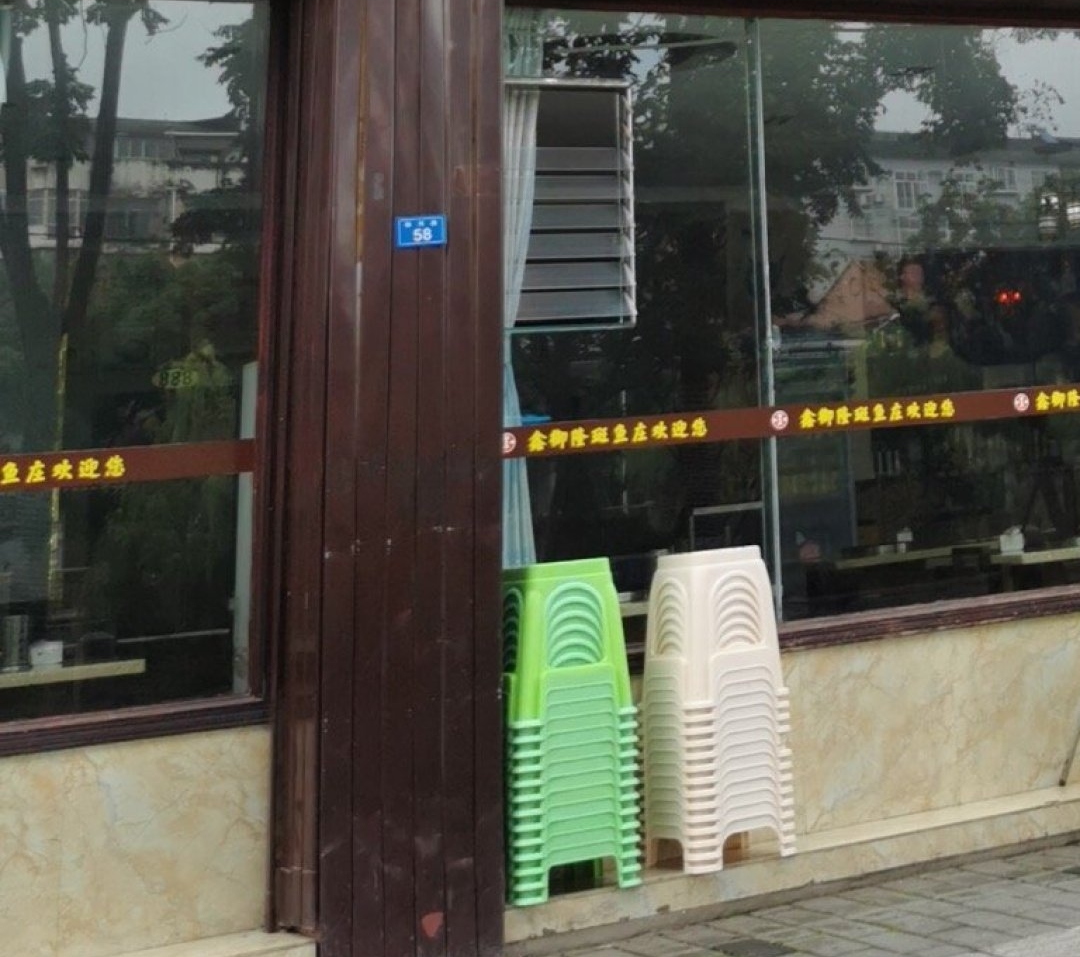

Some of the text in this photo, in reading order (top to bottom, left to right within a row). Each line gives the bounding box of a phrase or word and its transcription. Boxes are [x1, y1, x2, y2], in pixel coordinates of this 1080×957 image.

[413, 227, 433, 242] 58
[799, 398, 956, 430] 鑫御隆斑鱼庄欢迎您
[527, 416, 708, 453] 鑫御隆斑鱼庄欢迎您
[0, 454, 126, 485] 鱼庄欢迎您
